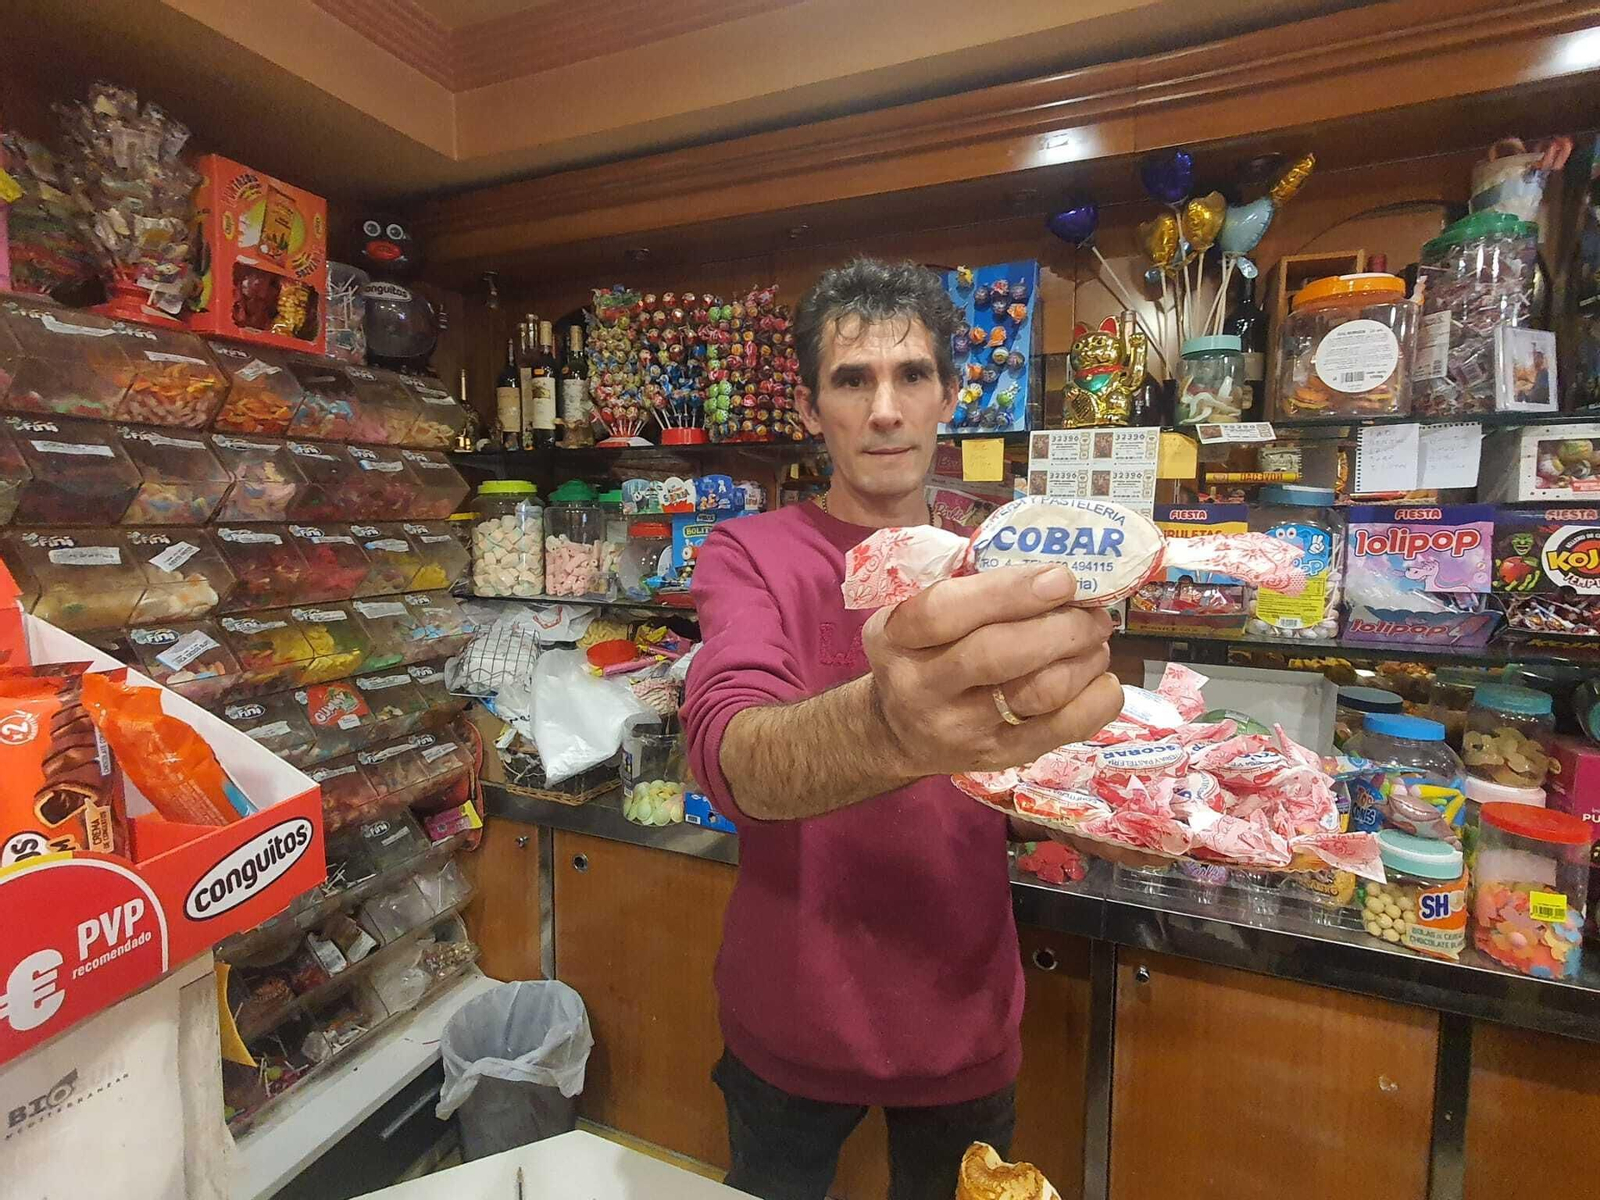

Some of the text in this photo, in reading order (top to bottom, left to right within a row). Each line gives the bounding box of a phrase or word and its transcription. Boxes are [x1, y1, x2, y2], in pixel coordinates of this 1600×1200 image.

[1170, 510, 1207, 520] FIESTA
[1395, 508, 1442, 520] FIESTA
[1545, 509, 1598, 520] FIESTA
[1355, 527, 1481, 560] lolipop
[1071, 561, 1114, 573] 494115
[1350, 618, 1449, 637] lolipop
[90, 818, 102, 846] CREMA
[194, 823, 309, 913] conguitos
[1421, 894, 1449, 919] SH
[77, 898, 145, 960] PVP
[71, 931, 153, 980] recomendado
